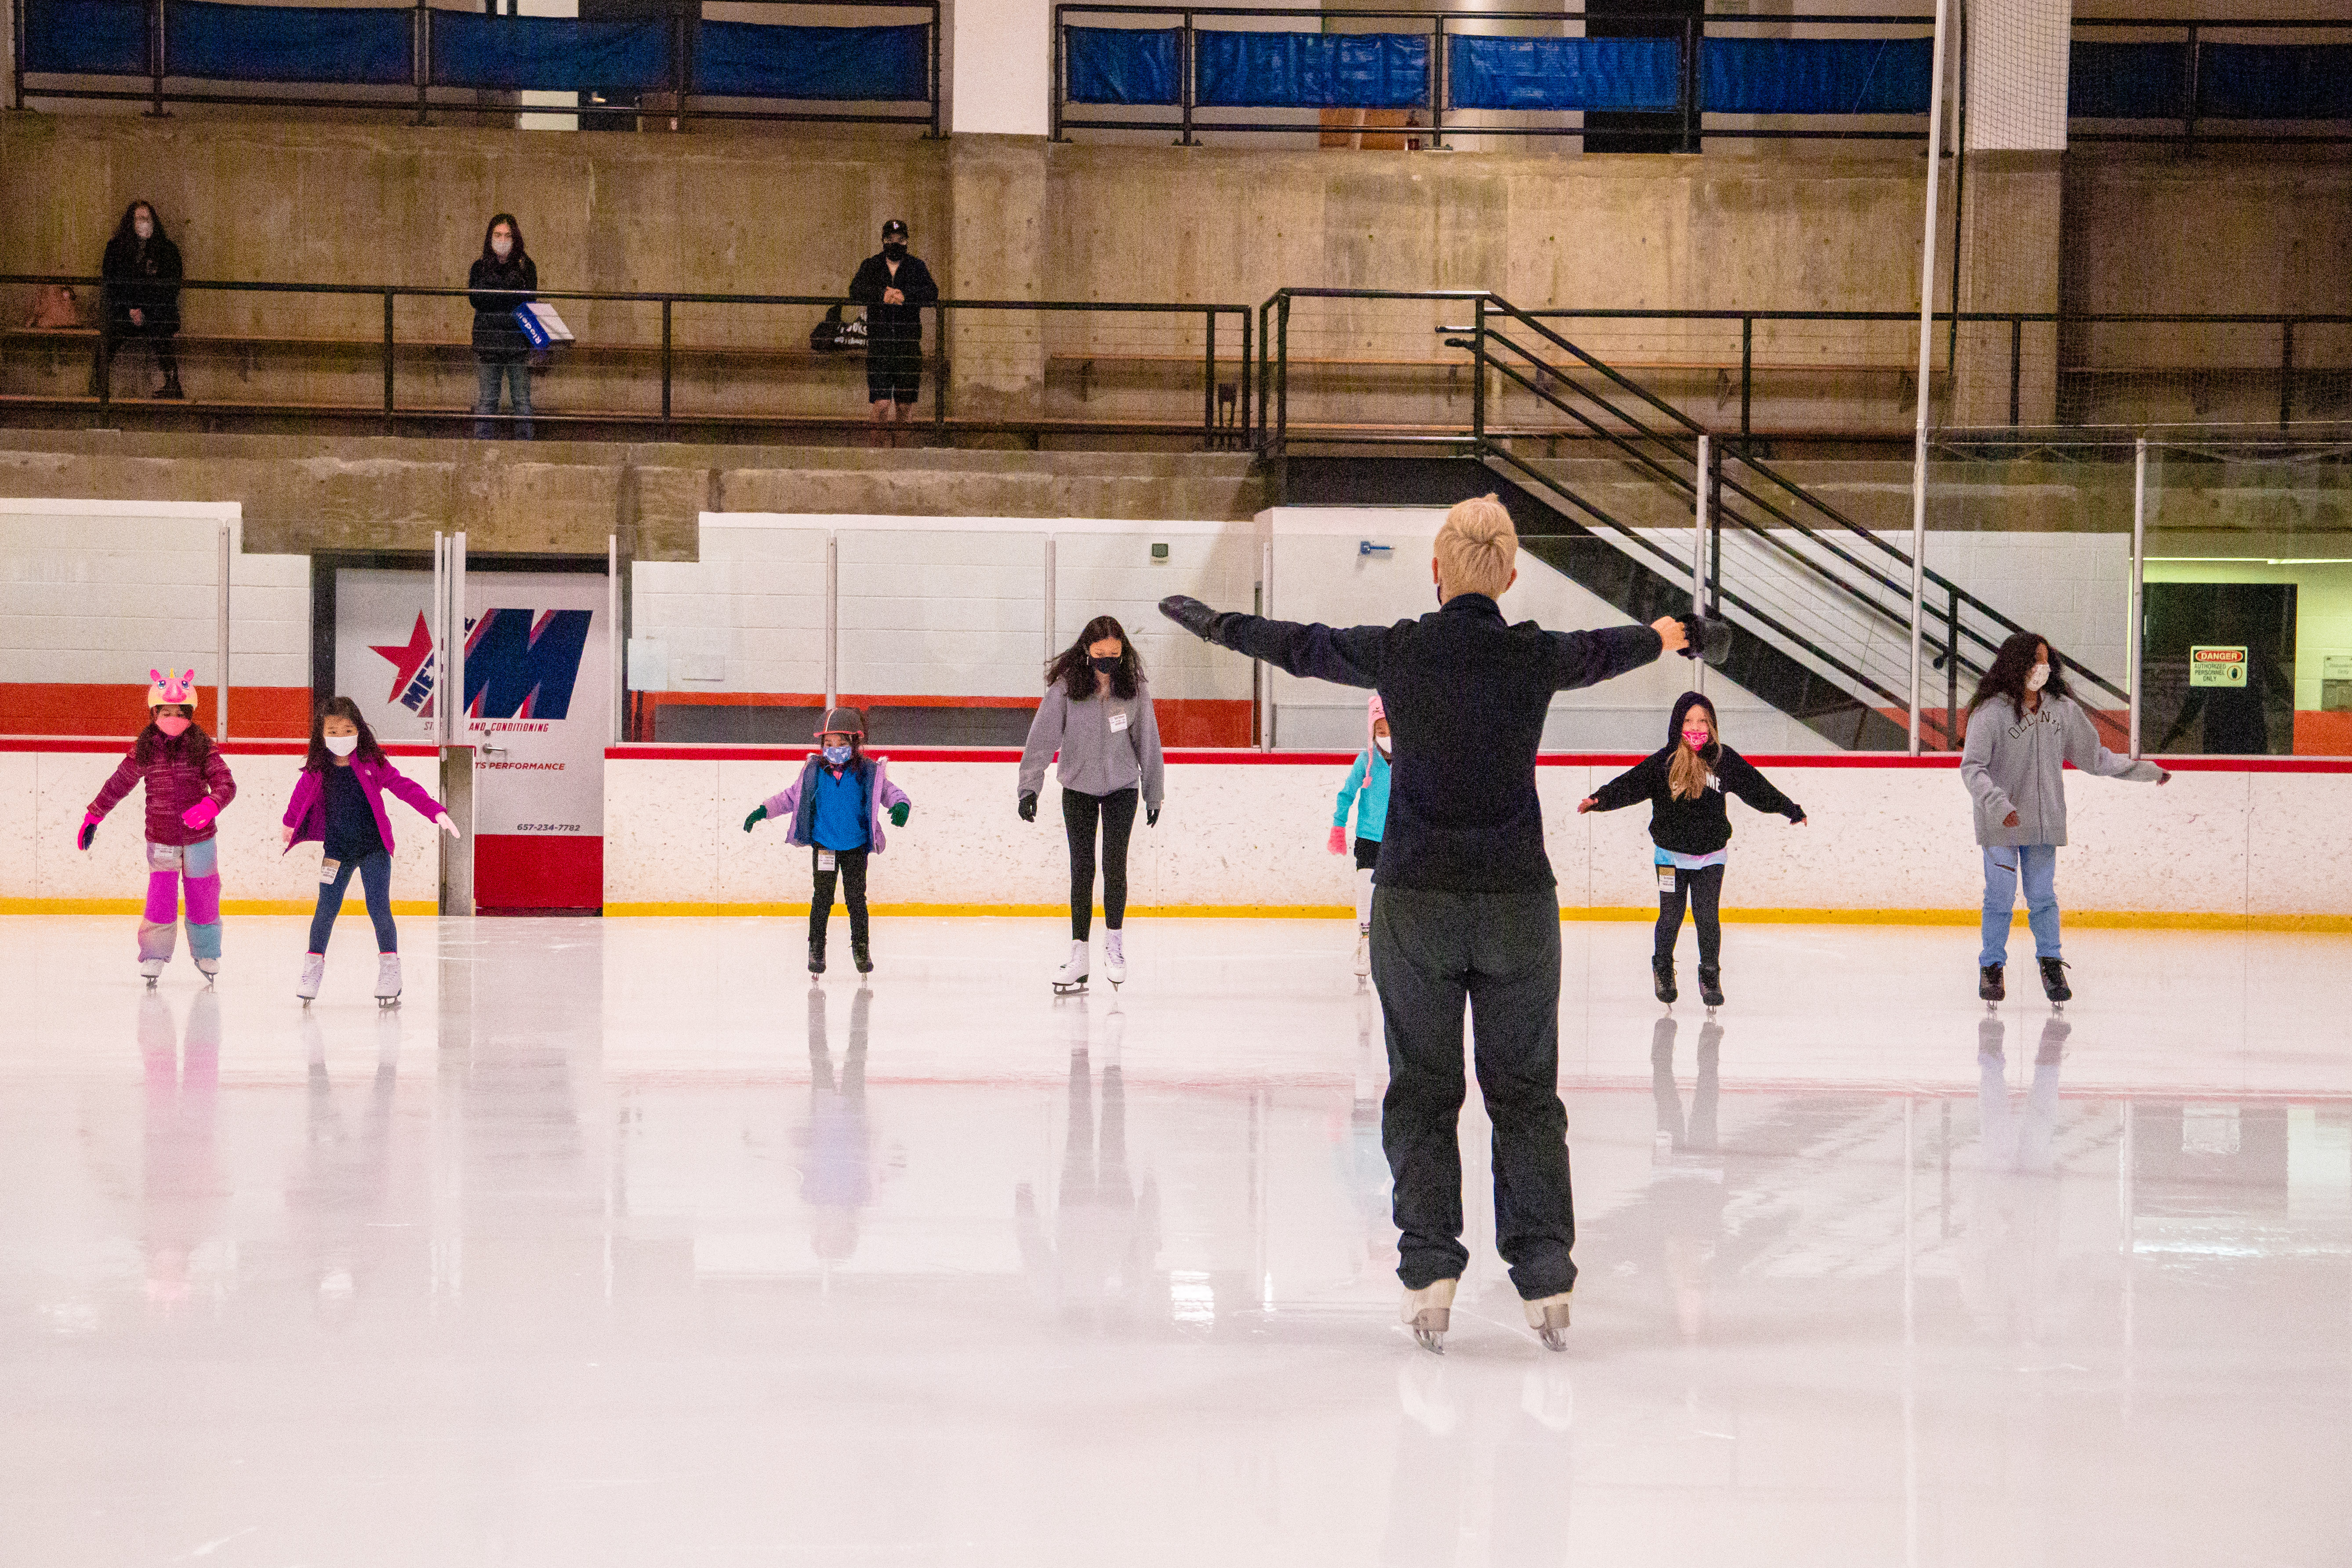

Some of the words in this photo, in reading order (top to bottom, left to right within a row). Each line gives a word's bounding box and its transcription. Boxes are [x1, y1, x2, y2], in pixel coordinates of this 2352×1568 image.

[469, 722, 486, 731] AND
[491, 723, 549, 732] CONDITIONING
[489, 762, 566, 770] PERFORMANCE
